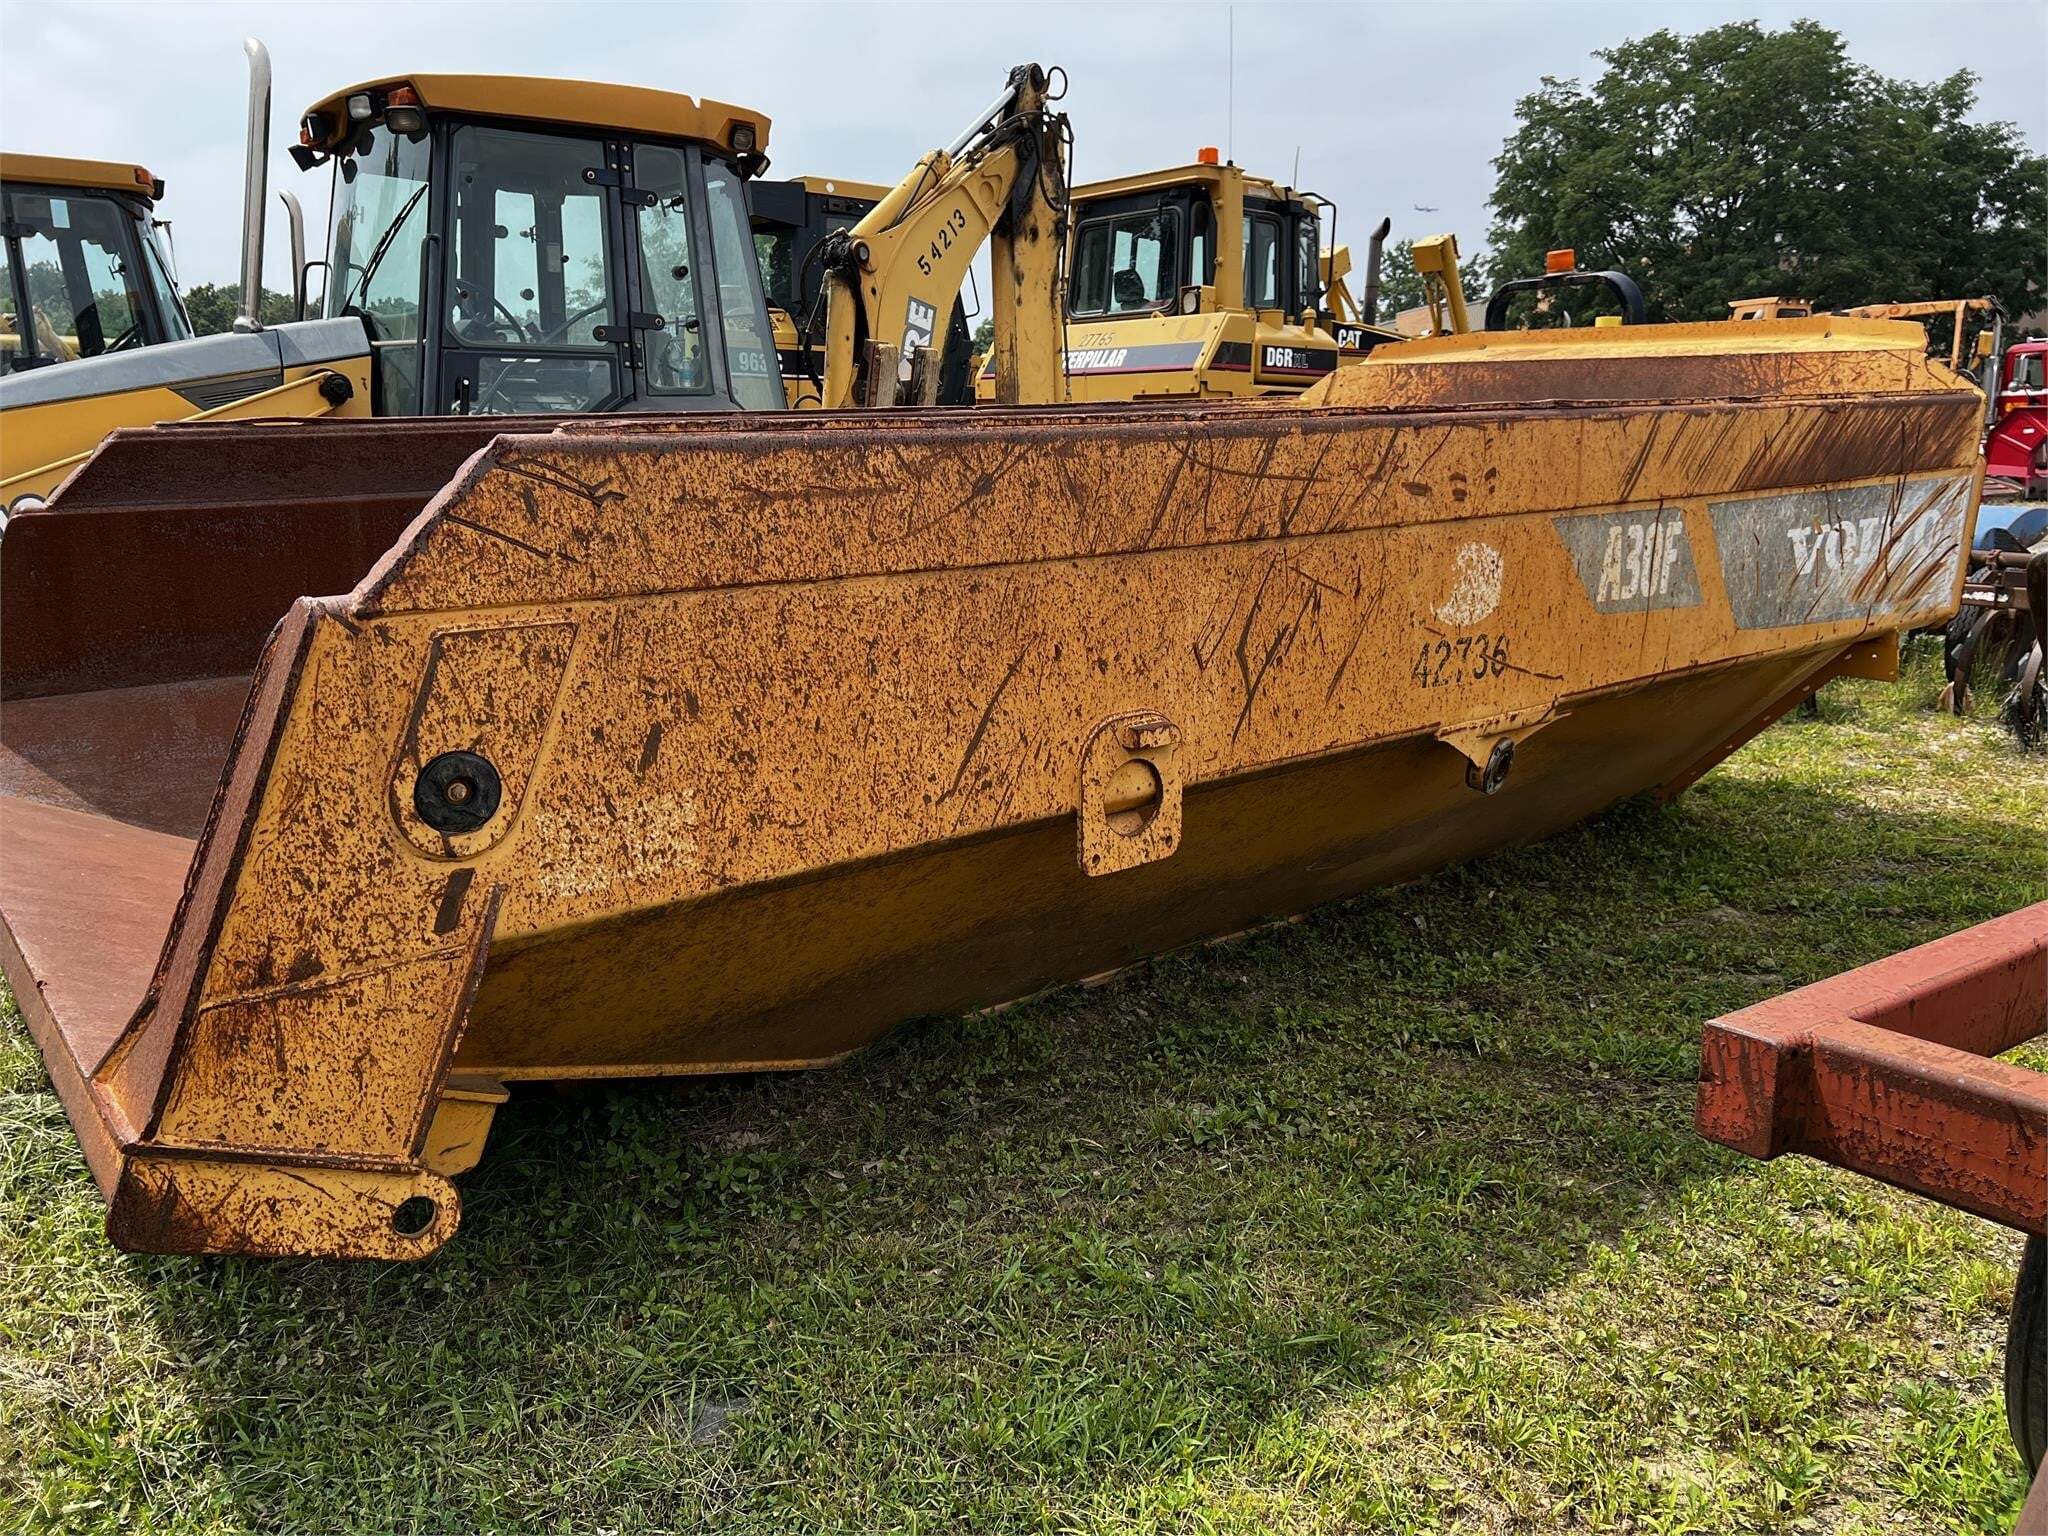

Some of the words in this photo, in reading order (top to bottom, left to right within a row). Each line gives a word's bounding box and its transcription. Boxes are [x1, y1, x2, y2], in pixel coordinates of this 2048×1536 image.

[917, 208, 966, 276] 54213
[903, 300, 935, 357] RE
[1078, 333, 1117, 347] 27765
[1338, 328, 1362, 350] CAT
[1266, 347, 1294, 368] D6R
[1596, 521, 1683, 602] A30F
[1411, 632, 1510, 689] 42736
